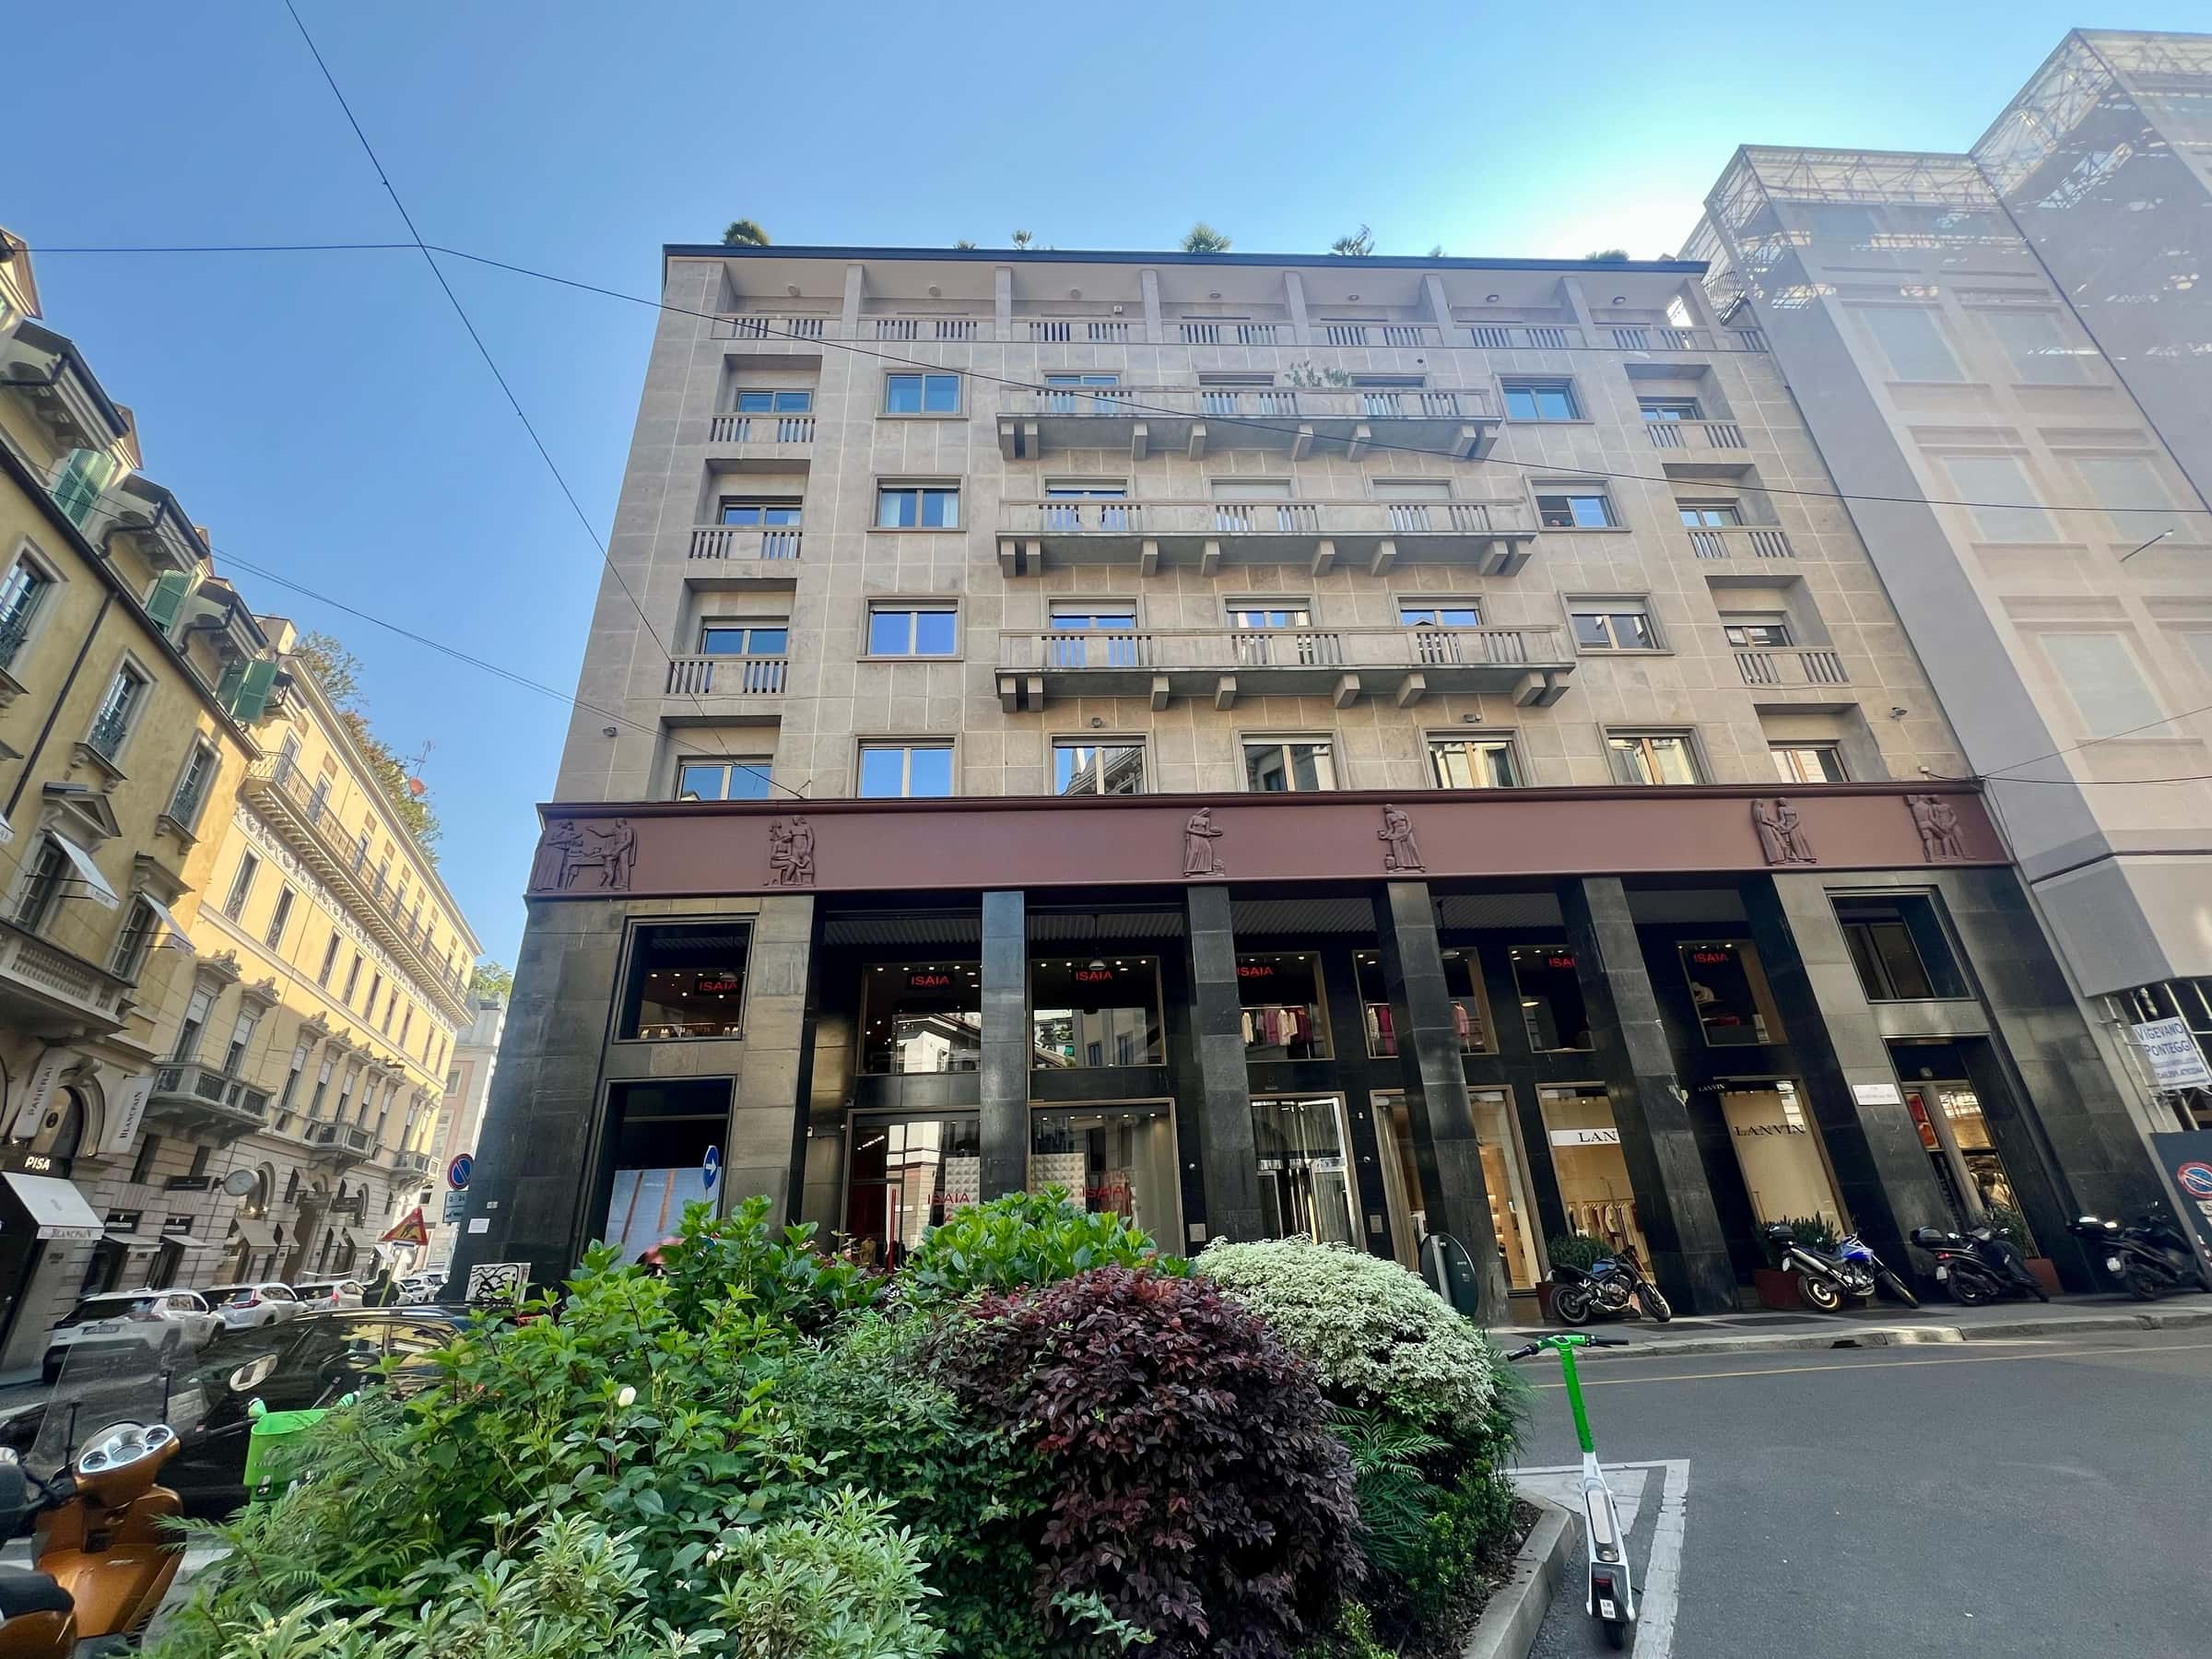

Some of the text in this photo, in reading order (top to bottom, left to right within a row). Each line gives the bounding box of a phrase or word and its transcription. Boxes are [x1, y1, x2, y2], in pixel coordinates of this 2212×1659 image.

[1548, 958, 1576, 967] ISAI
[1076, 971, 1113, 982] ISAIA
[1237, 967, 1274, 977] ISAIA
[699, 980, 737, 992] ISAIA
[911, 975, 949, 986] ISAIA
[2136, 1022, 2183, 1041] VIGEVANO
[28, 1067, 53, 1115] PANERAI
[1698, 1083, 1725, 1092] LANVIN
[1734, 1124, 1806, 1136] LANVIN
[1577, 1131, 1618, 1142] LAN
[24, 1156, 52, 1171] PISA
[928, 1193, 970, 1204] ISAIA
